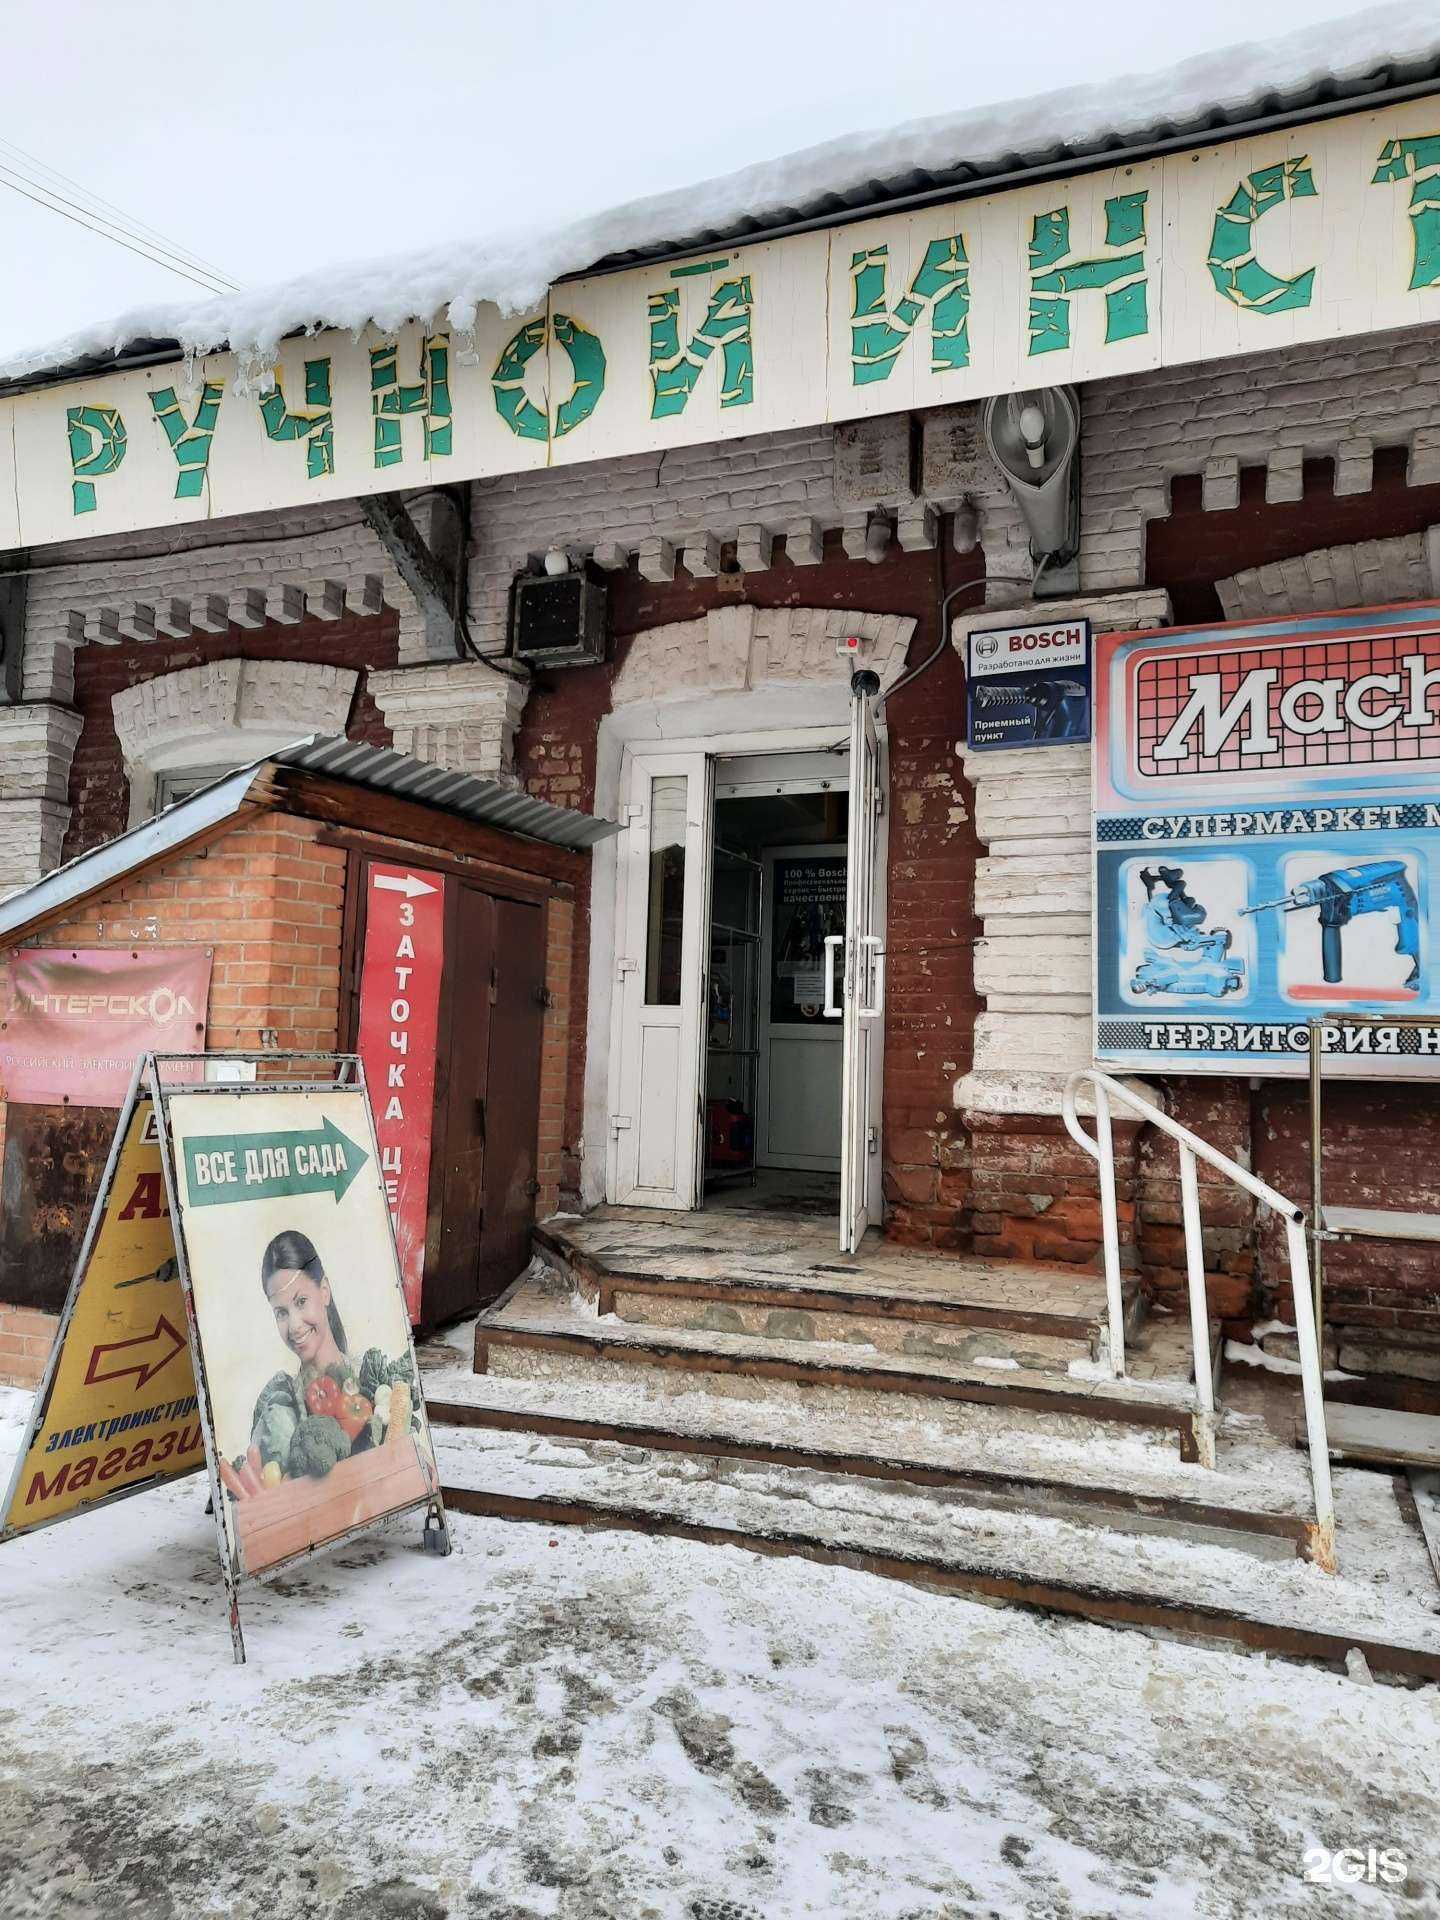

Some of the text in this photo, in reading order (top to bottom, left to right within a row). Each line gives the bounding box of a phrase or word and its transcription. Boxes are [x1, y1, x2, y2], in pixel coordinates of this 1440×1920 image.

[66, 134, 1440, 516] РУЧНОЙ ИНСТ
[1008, 628, 1081, 652] BOSCH
[978, 654, 1081, 671] Разработано для жизни
[974, 715, 1031, 730] Приемный
[1153, 653, 1440, 762] Mach
[974, 731, 1004, 743] пункт
[1142, 805, 1405, 840] СУПЕРМАРКЕТ
[384, 902, 416, 1120] ЗАТОЧКА
[1144, 1024, 1401, 1053] ТЕРРИТОРИЯ
[194, 1143, 349, 1186] ВСЕ ДЛЯ САДА
